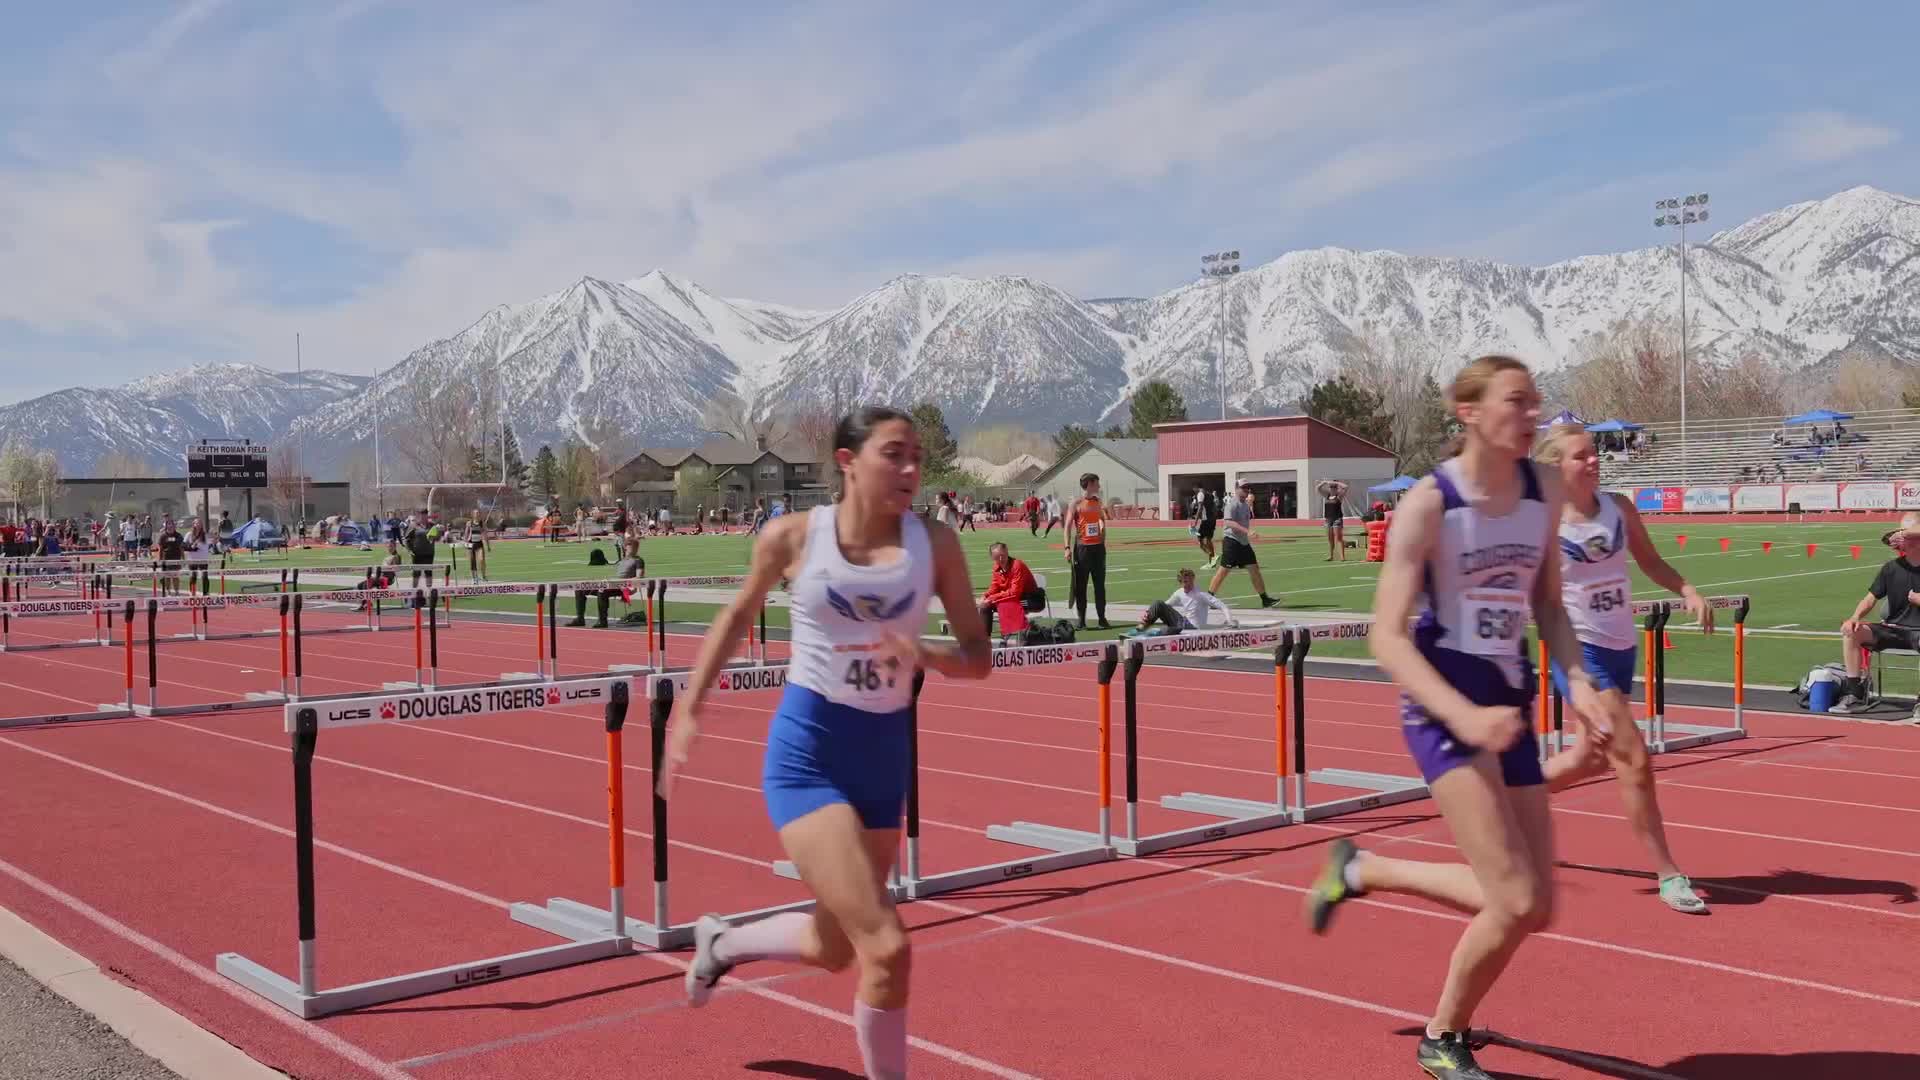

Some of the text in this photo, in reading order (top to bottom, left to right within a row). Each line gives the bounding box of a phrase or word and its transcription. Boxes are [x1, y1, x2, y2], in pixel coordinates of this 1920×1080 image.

[197, 446, 267, 454] KEITH ROMAN FIELD
[1901, 487, 1920, 497] RE/
[331, 592, 364, 601] DOUGLAS
[365, 590, 391, 600] TIGERS
[463, 586, 493, 595] DOUGLAS
[493, 585, 515, 594] TIGERS
[20, 602, 61, 613] DOUGLAS
[63, 601, 93, 611] TIGERS
[190, 598, 225, 607] DOUGLAS
[226, 595, 254, 605] TIGERS
[1589, 588, 1625, 613] 454
[1340, 623, 1369, 638] DOUGLA
[1146, 643, 1167, 652] UCS
[1178, 633, 1220, 653] DOUGLAS
[1220, 632, 1250, 650] TIGERS
[992, 647, 1100, 668] GLAS TIGERS UCS
[732, 670, 787, 691] DOUGLA
[329, 687, 601, 721] UCS DOUGLAS TIGERS UCS
[1003, 862, 1033, 877] UCS
[454, 964, 502, 985] UCS
